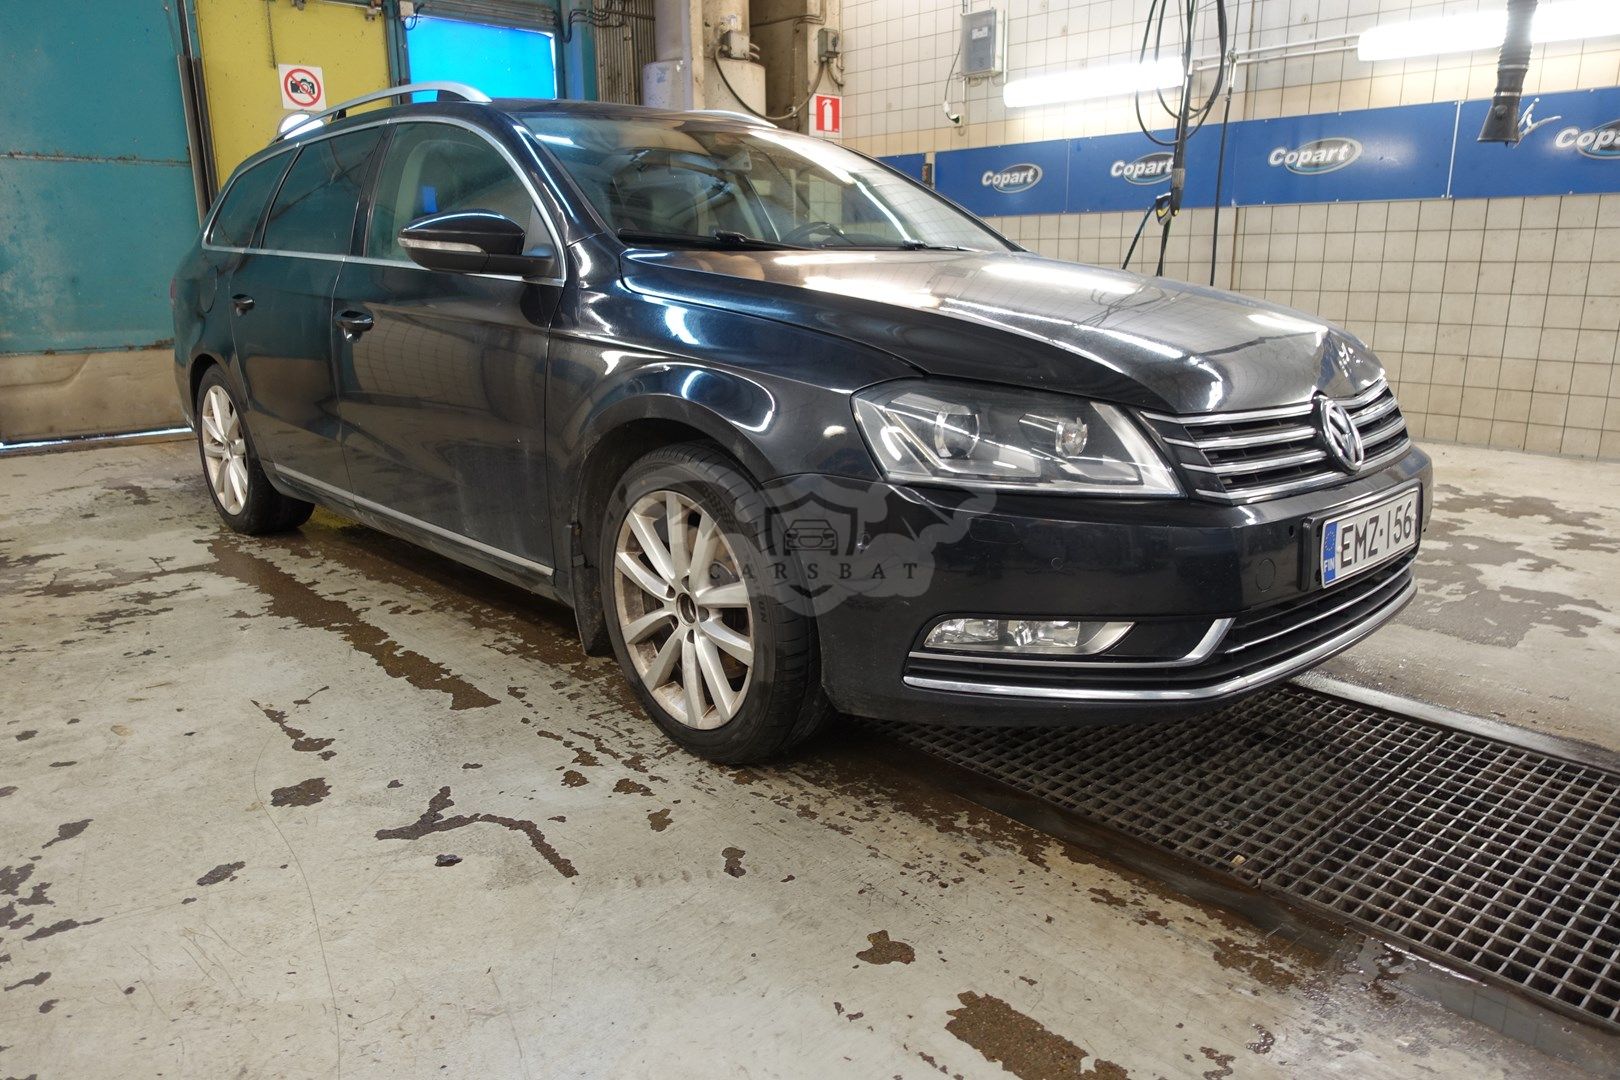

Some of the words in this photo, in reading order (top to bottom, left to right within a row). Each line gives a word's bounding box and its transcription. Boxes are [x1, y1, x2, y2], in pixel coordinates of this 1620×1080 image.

[1269, 144, 1349, 168] Copart
[981, 168, 1035, 188] Copart
[1110, 157, 1174, 179] Copart
[1340, 500, 1412, 569] EMZ-156
[1323, 560, 1335, 573] FIN
